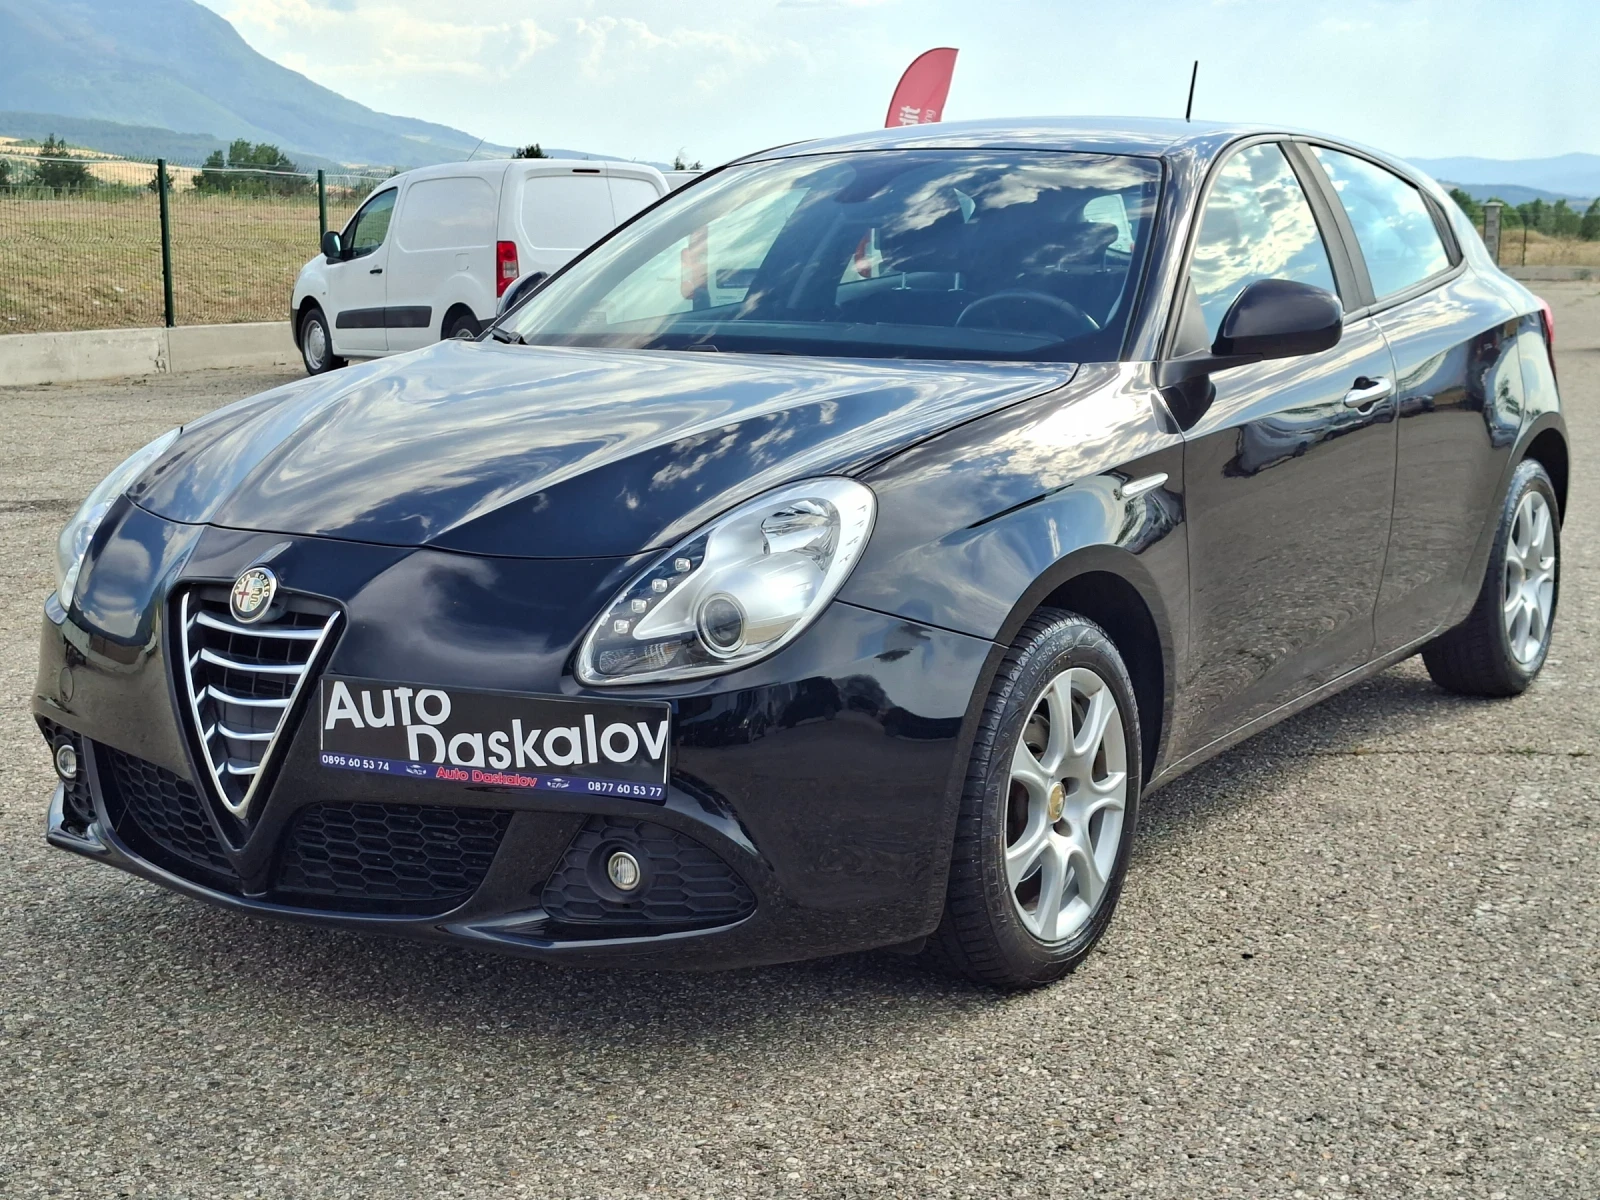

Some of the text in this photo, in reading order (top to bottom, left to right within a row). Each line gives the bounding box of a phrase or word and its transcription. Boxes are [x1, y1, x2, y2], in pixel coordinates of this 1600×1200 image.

[325, 681, 451, 729] Auto
[407, 714, 668, 769] Daskalov
[322, 755, 390, 771] 0895 60 53 74
[436, 766, 537, 787] Auto Daskalov
[588, 781, 662, 797] 0877 60 53 77
